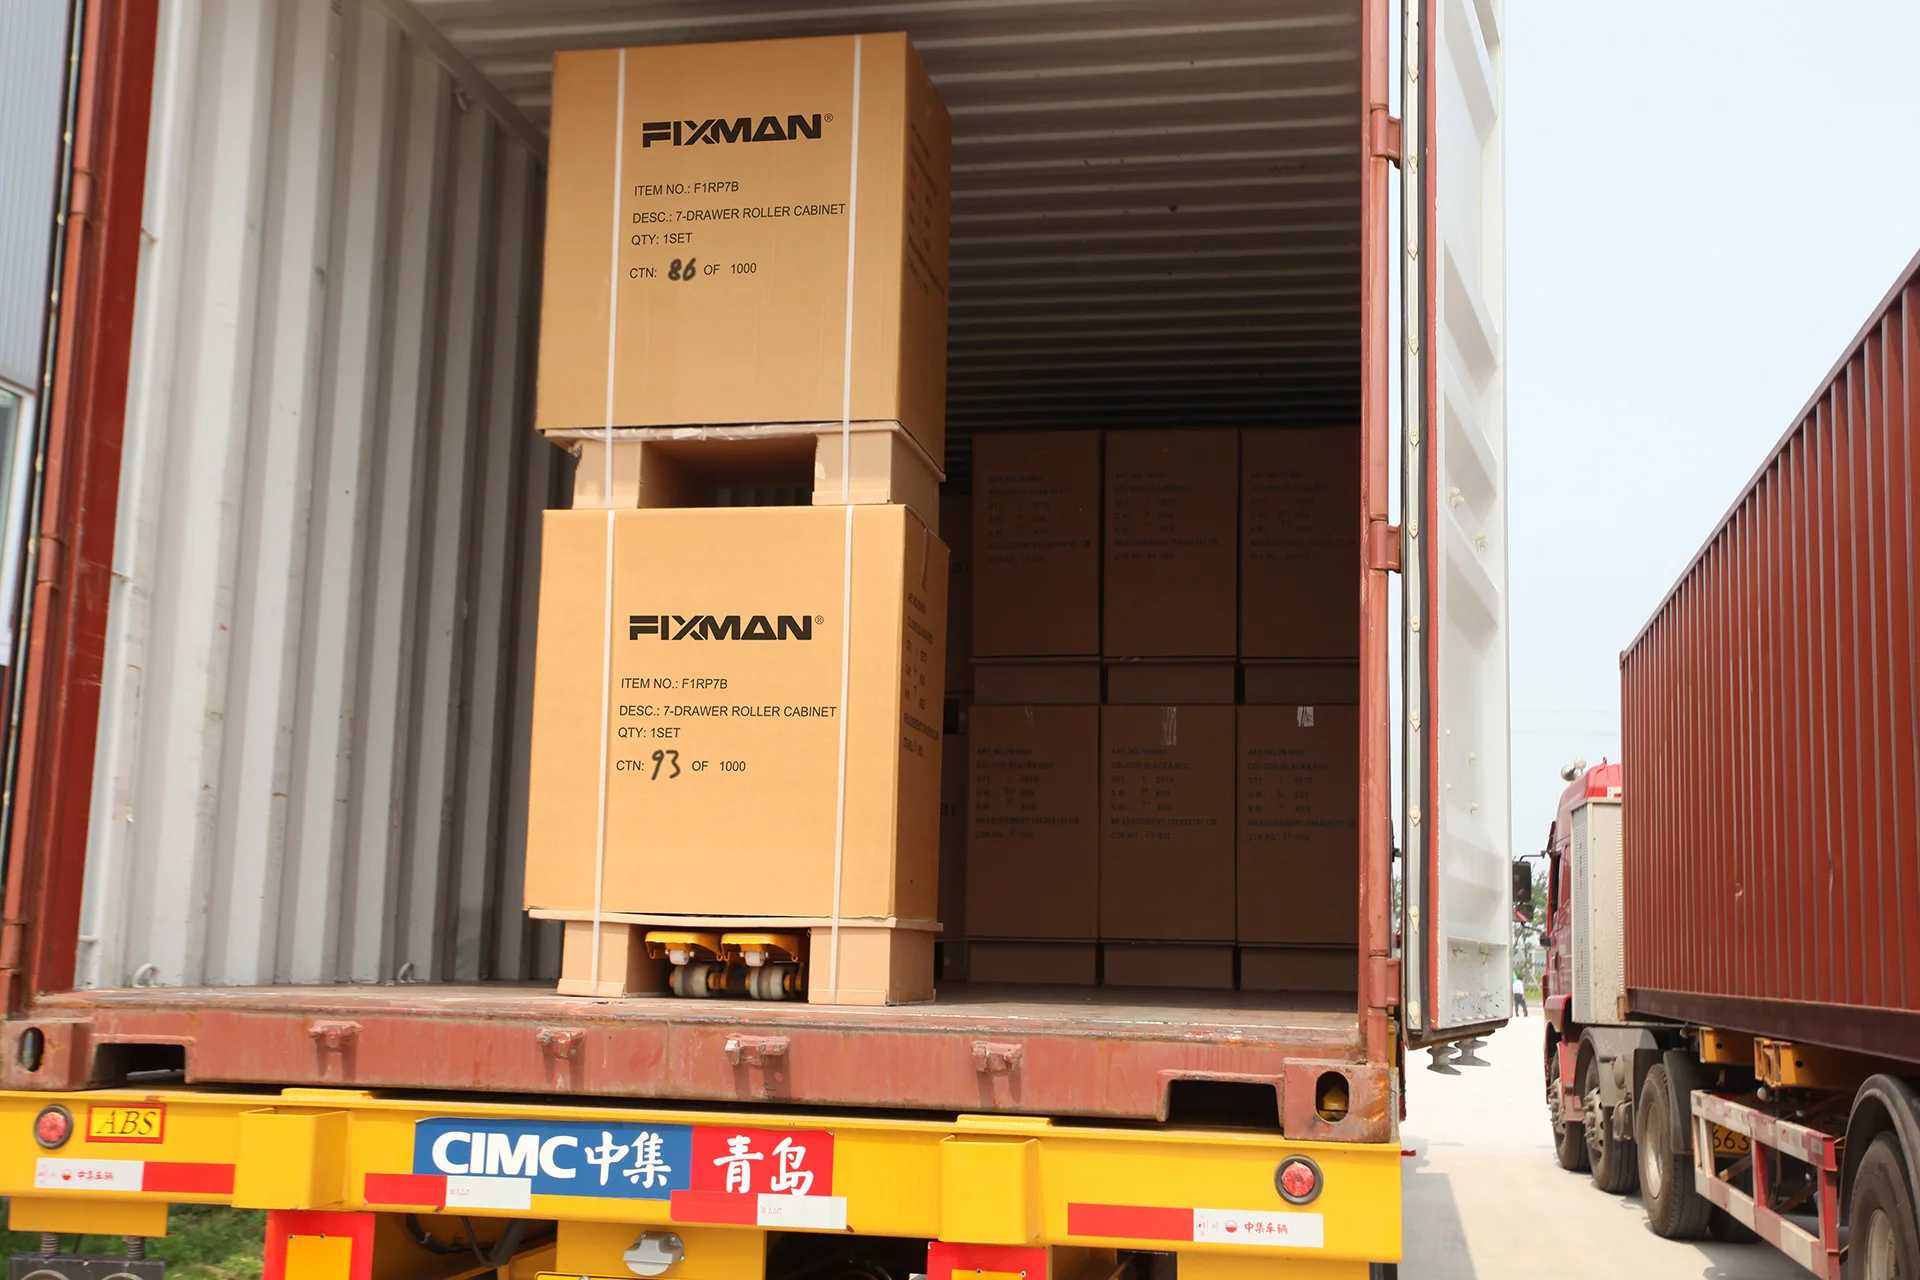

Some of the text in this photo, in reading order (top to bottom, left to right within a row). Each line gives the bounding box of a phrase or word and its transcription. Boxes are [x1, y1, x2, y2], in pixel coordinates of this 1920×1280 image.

[634, 181, 739, 196] ITEM NO.: F1RP7B
[632, 203, 846, 224] DESC.: 7-DRAWER ROLLER CABINET
[631, 232, 693, 246] QTY: 1SET
[629, 257, 757, 281] CTN: 86 OF 1000
[621, 678, 728, 689] ITEM NO.: F1RP7B
[619, 704, 837, 718] DESC.: 7-DRAWER ROLLER CABINET
[617, 727, 681, 739] QTY: 1SET
[616, 749, 746, 781] CTN: 93 OF 1000
[95, 1110, 159, 1136] ABS
[431, 1130, 815, 1196] CIMC 中集 青岛
